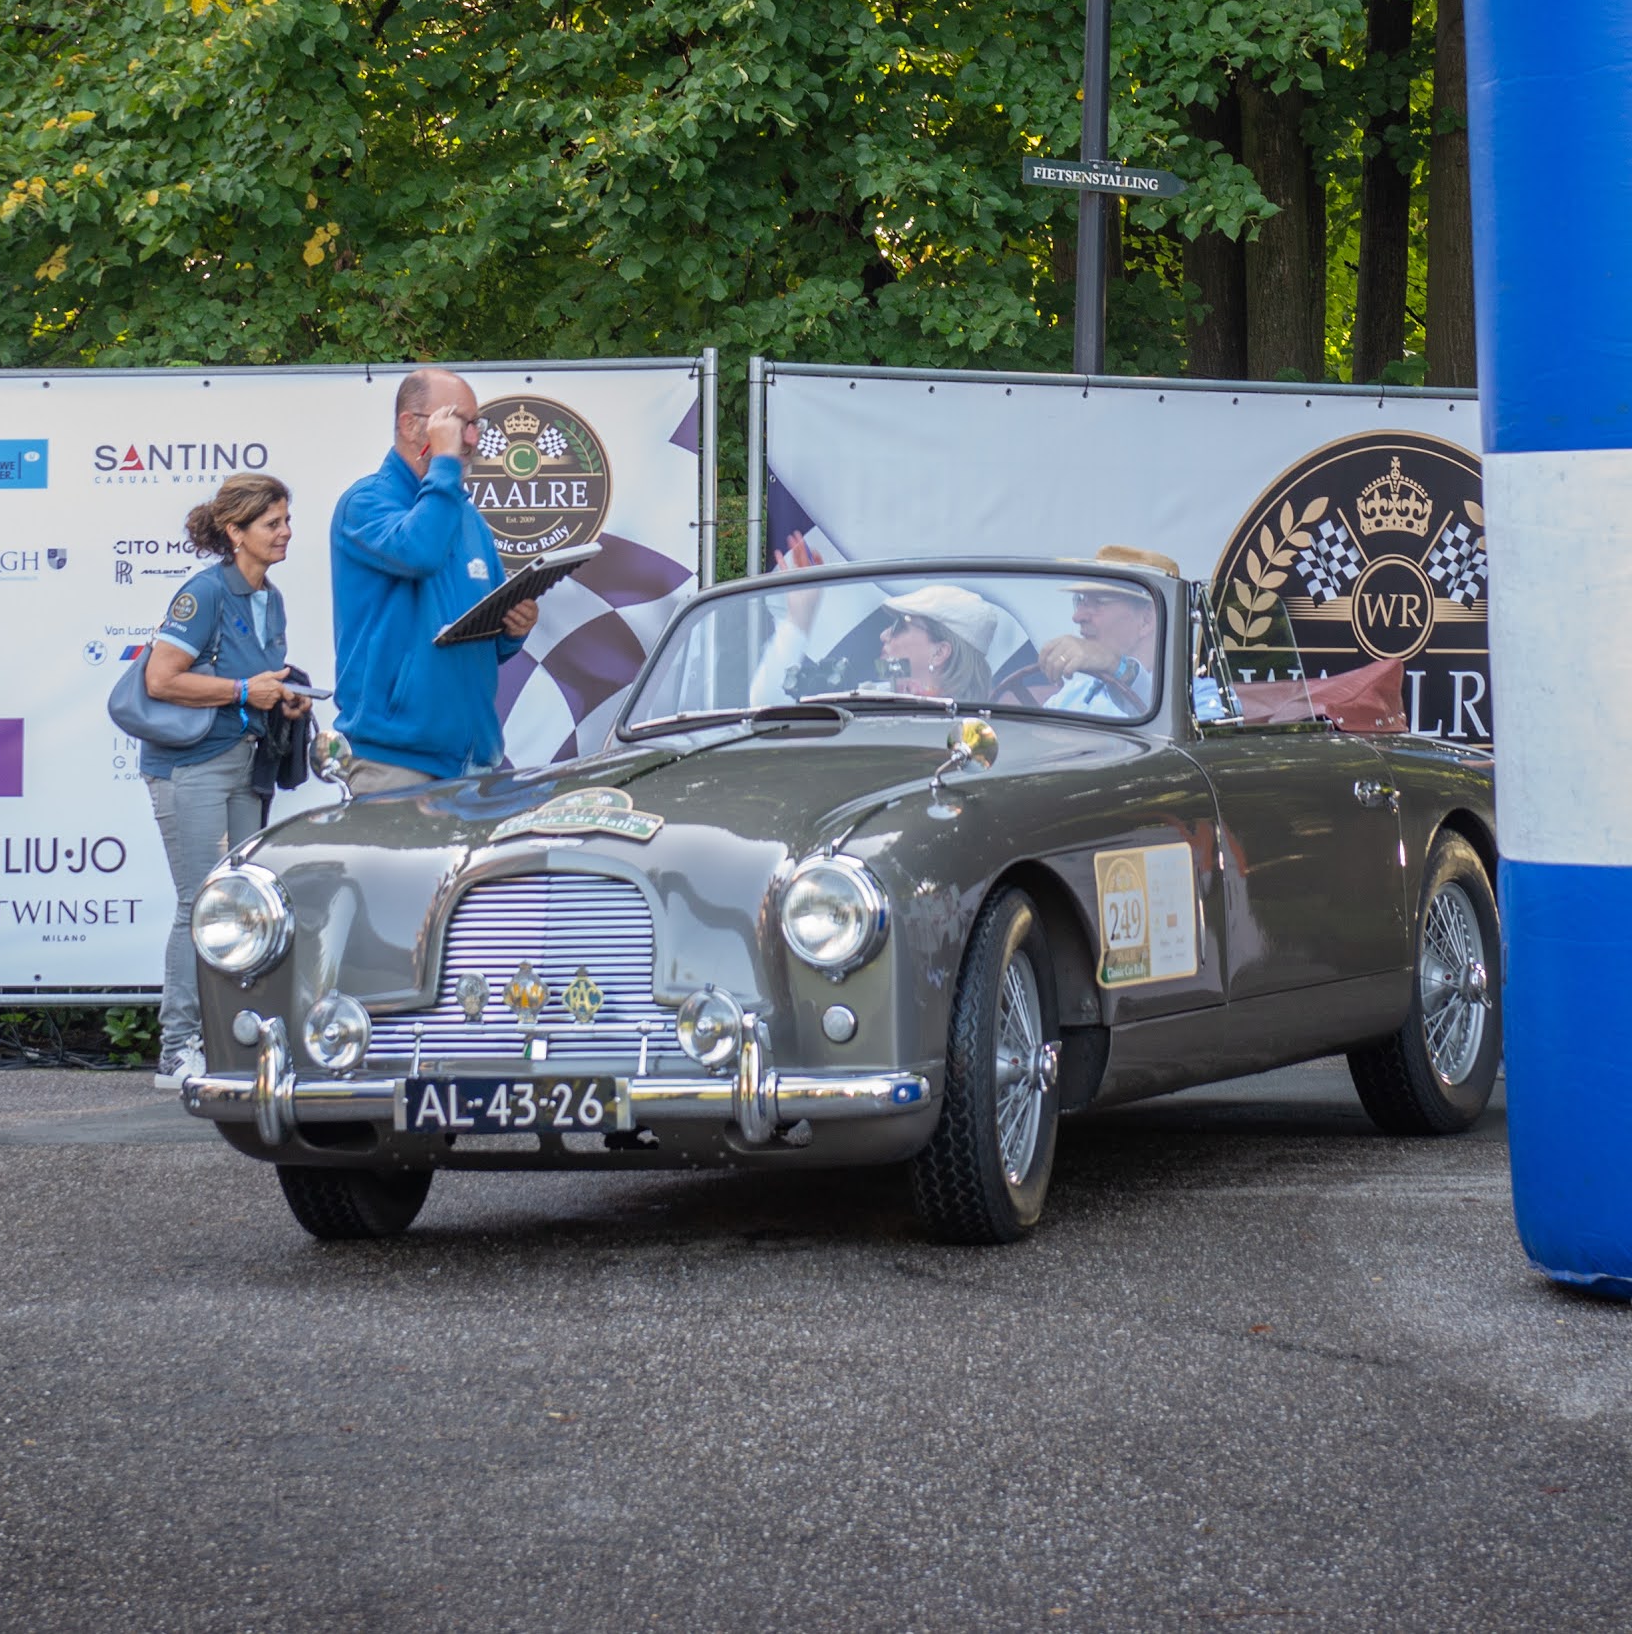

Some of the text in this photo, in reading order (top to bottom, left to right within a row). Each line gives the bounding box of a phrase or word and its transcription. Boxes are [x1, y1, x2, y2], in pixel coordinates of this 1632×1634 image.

[1033, 166, 1159, 190] FIETSENSTALLING
[94, 443, 268, 472] SANTINO
[509, 448, 531, 473] C
[95, 476, 160, 484] CASUAL
[505, 516, 536, 524] Est. 2009
[114, 540, 159, 555] CITO
[516, 540, 538, 554] Car
[539, 525, 570, 550] Rally
[1361, 592, 1424, 628] WR
[105, 625, 125, 635] Van
[1109, 898, 1142, 942] 249
[42, 934, 87, 942] MILANO
[415, 1083, 604, 1127] AL-43-26
